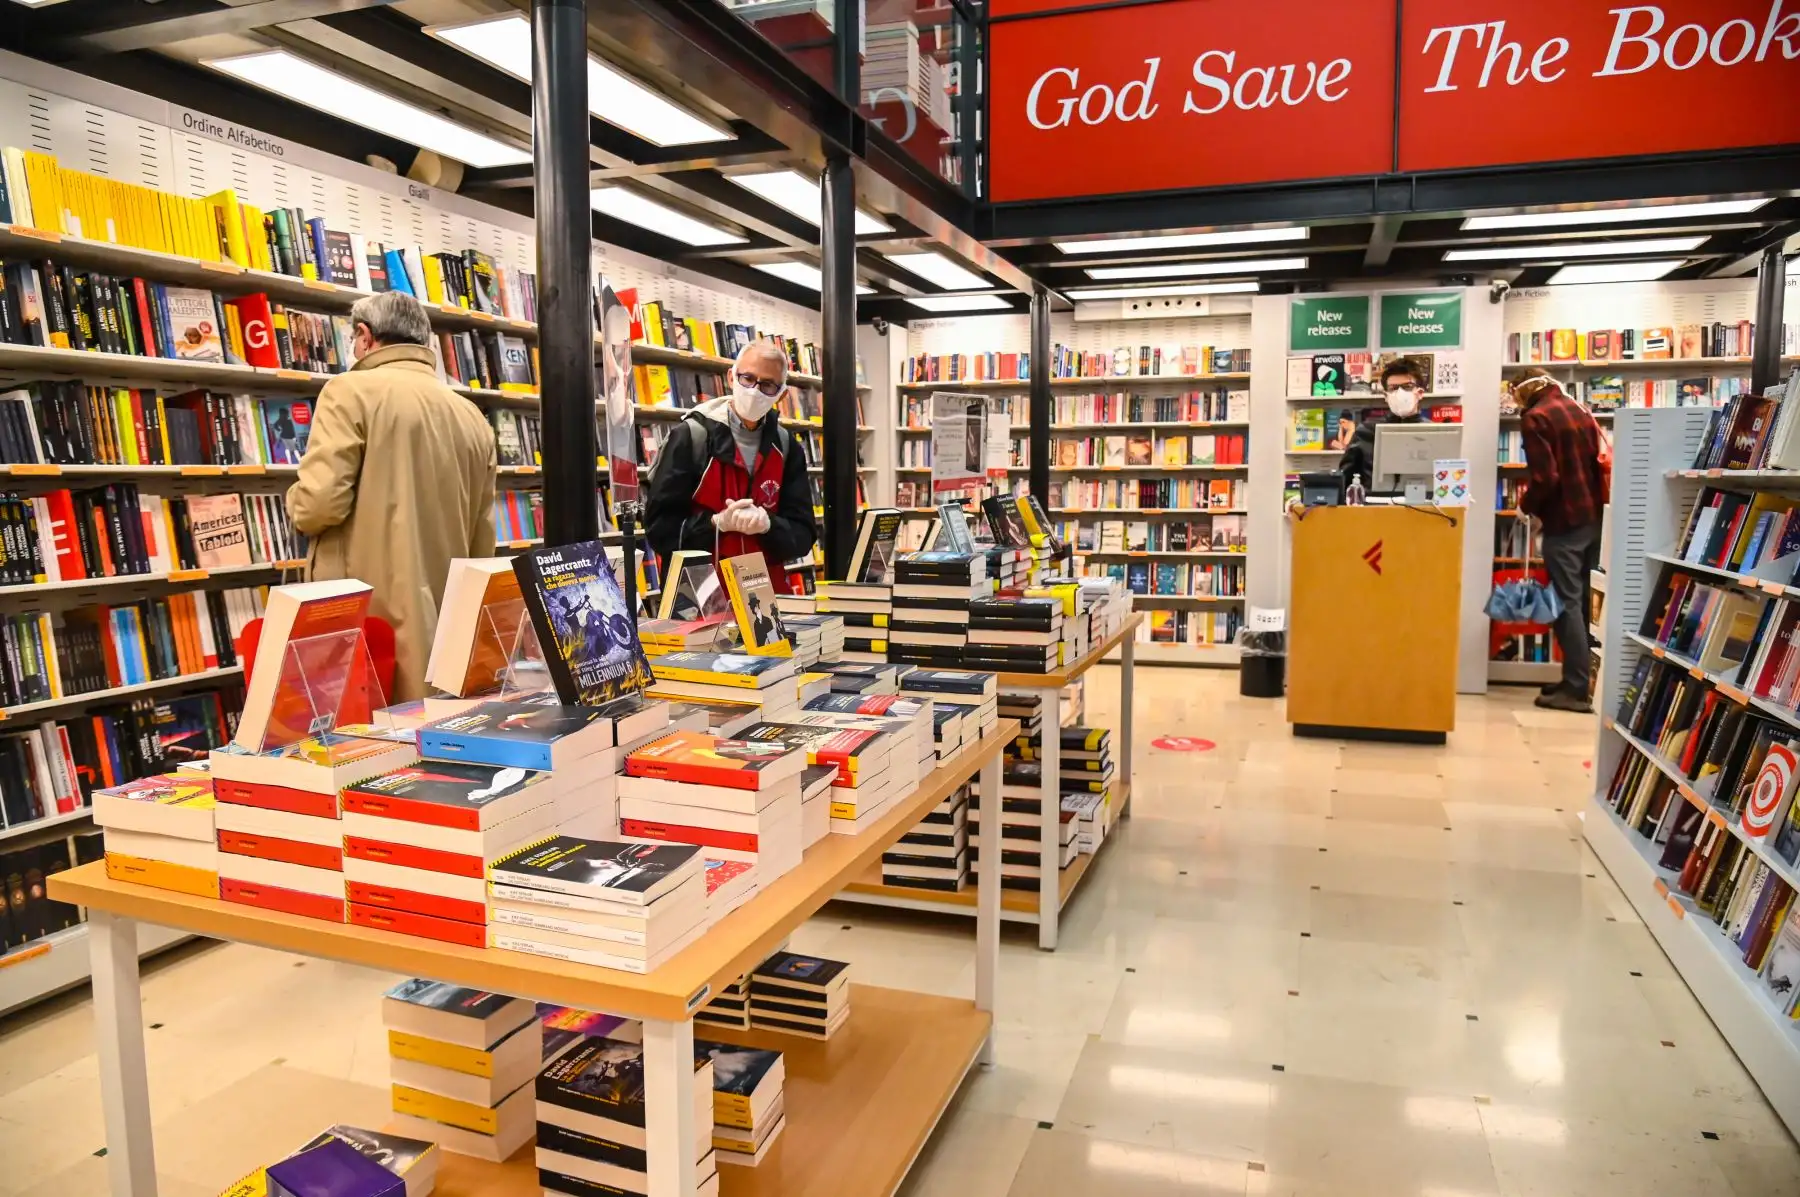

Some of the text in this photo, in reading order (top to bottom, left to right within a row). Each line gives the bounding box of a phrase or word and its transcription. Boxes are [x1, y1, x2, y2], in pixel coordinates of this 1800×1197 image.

[1026, 56, 1161, 130] God
[1182, 50, 1352, 114] Save
[1421, 19, 1570, 93] The
[183, 112, 284, 156] Ordine Alfabetico
[624, 303, 641, 323] M
[1317, 310, 1343, 322] New
[1408, 308, 1435, 320] New
[245, 320, 270, 348] G
[1307, 324, 1352, 336] releases
[1398, 322, 1444, 334] releases
[1314, 355, 1344, 364] ATWOOD
[193, 513, 244, 532] American
[200, 530, 244, 552] Tabloid
[536, 552, 563, 566] David
[540, 558, 592, 576] Lagercrantz
[546, 582, 558, 590] che
[552, 572, 576, 583] ragazza
[578, 662, 634, 689] MILLENNIUM 6
[543, 1059, 568, 1078] David
[552, 1046, 597, 1080] Lagercrantz
